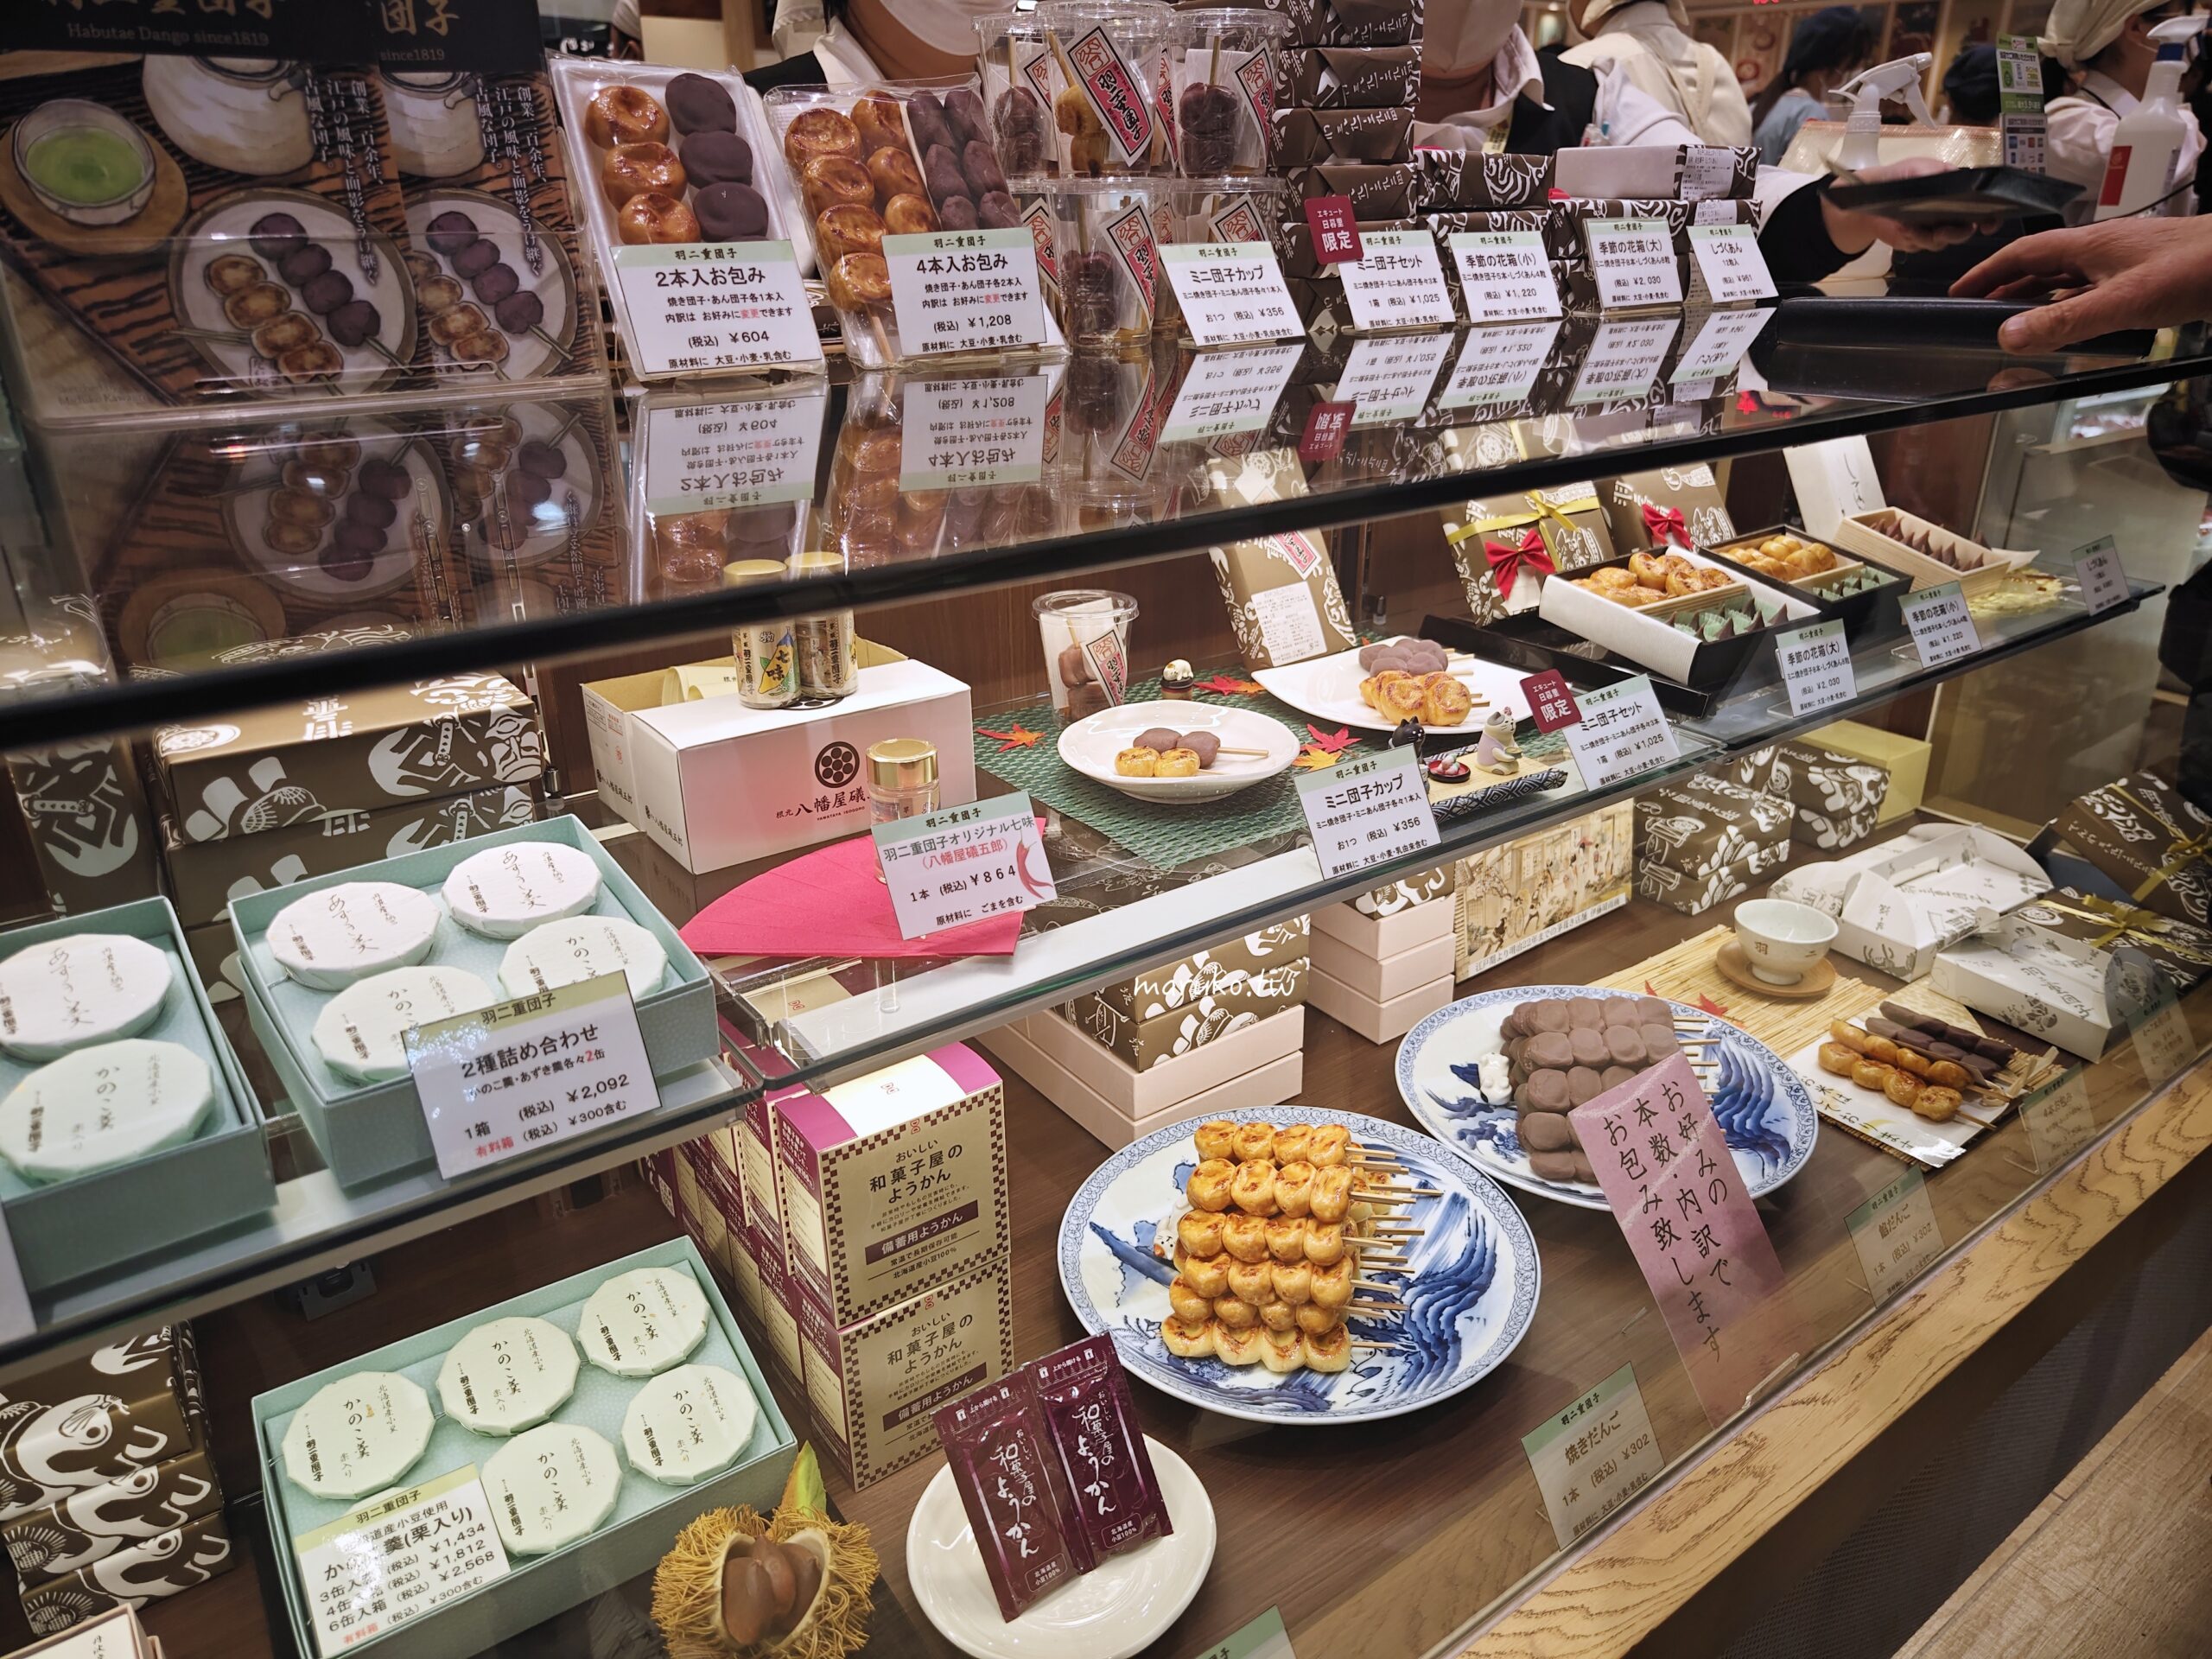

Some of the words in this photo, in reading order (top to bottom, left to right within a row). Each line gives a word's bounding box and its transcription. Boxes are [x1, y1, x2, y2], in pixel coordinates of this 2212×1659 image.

[67, 24, 135, 39] Habutae
[139, 27, 190, 45] Dango
[380, 48, 445, 61] since1819
[1317, 207, 1343, 218] エキュート
[1322, 218, 1344, 230] 日暮里
[675, 248, 738, 259] 羽二重団子
[934, 238, 986, 248] 羽二重団子
[1198, 247, 1238, 257] 羽二重団子
[1321, 232, 1354, 252] 限定
[1366, 236, 1402, 245] 羽二重団子
[917, 253, 1008, 274] 4本入お包み
[1191, 265, 1264, 283] ミニ団子カップ
[1357, 255, 1423, 270] ミニ団子セット
[655, 267, 765, 288] 2本入お包み
[925, 279, 1021, 293] 焼き団子・あん団子各2本入
[668, 292, 785, 307] 焼き団子・あん団子各1本入
[1259, 307, 1285, 318] ¥356
[1409, 294, 1440, 304] ¥1,025
[968, 315, 1011, 328] ¥1,208
[729, 331, 769, 343] ¥604
[1533, 681, 1556, 692] エキュート
[1541, 700, 1572, 722] 限定
[1580, 702, 1642, 731] ミニ団子セット
[1635, 734, 1663, 750] ¥1,025
[1336, 761, 1377, 779] 羽二重団子
[795, 786, 870, 816] 八幡屋礒
[1325, 773, 1403, 808] ミニ団子カップ
[926, 808, 981, 827] 羽二重団子
[1393, 817, 1421, 831] ¥356
[884, 815, 1034, 861] 羽二重団子オリジナル七味
[910, 889, 929, 902] 1本
[940, 880, 967, 896] (税込)
[936, 909, 971, 925] 原材料に
[982, 895, 1023, 913] ごまを含む
[481, 993, 556, 1025] 羽二重団子
[462, 1023, 599, 1078] 2種詰め合わせ
[465, 1121, 491, 1140] 1箱
[518, 1100, 555, 1121] (税込)
[566, 1075, 629, 1103] ¥2,092
[475, 1136, 514, 1158] 有料箱
[896, 1141, 938, 1163] おいしい
[1662, 1080, 1727, 1204] お好みの
[869, 1145, 963, 1192] 和菓子屋の
[888, 1168, 950, 1204] ようかん
[1633, 1097, 1731, 1287] 本数・内訳で
[882, 1213, 963, 1255] 備蓄用ようかん
[1603, 1114, 1721, 1363] お包み致します
[887, 1314, 972, 1365] 和菓子屋の
[912, 1313, 950, 1337] おいしい
[905, 1338, 962, 1374] ようかん
[899, 1376, 973, 1421] 備蓄用ようかん
[1097, 1391, 1111, 1421] おいしい
[1560, 1393, 1599, 1425] 羽二重団子
[1016, 1429, 1032, 1461] おいしい
[1072, 1403, 1115, 1466] 和菓子屋の
[1565, 1410, 1621, 1465] 焼きだんご
[990, 1443, 1036, 1506] 和菓子屋の
[1077, 1434, 1116, 1516] ようかん
[1562, 1488, 1580, 1506] 1本
[1591, 1459, 1617, 1488] (税込)
[1622, 1433, 1649, 1460] ¥302
[356, 1490, 421, 1524] 羽二重団子
[358, 1500, 448, 1541] 道産小豆使用
[997, 1478, 1039, 1558] ようかん
[324, 1507, 472, 1581] か羹(栗入り)
[430, 1523, 486, 1553] ¥1,434
[429, 1541, 486, 1570] ¥1,812
[329, 1602, 387, 1631] 6缶入箱
[439, 1551, 494, 1581] ¥2,568
